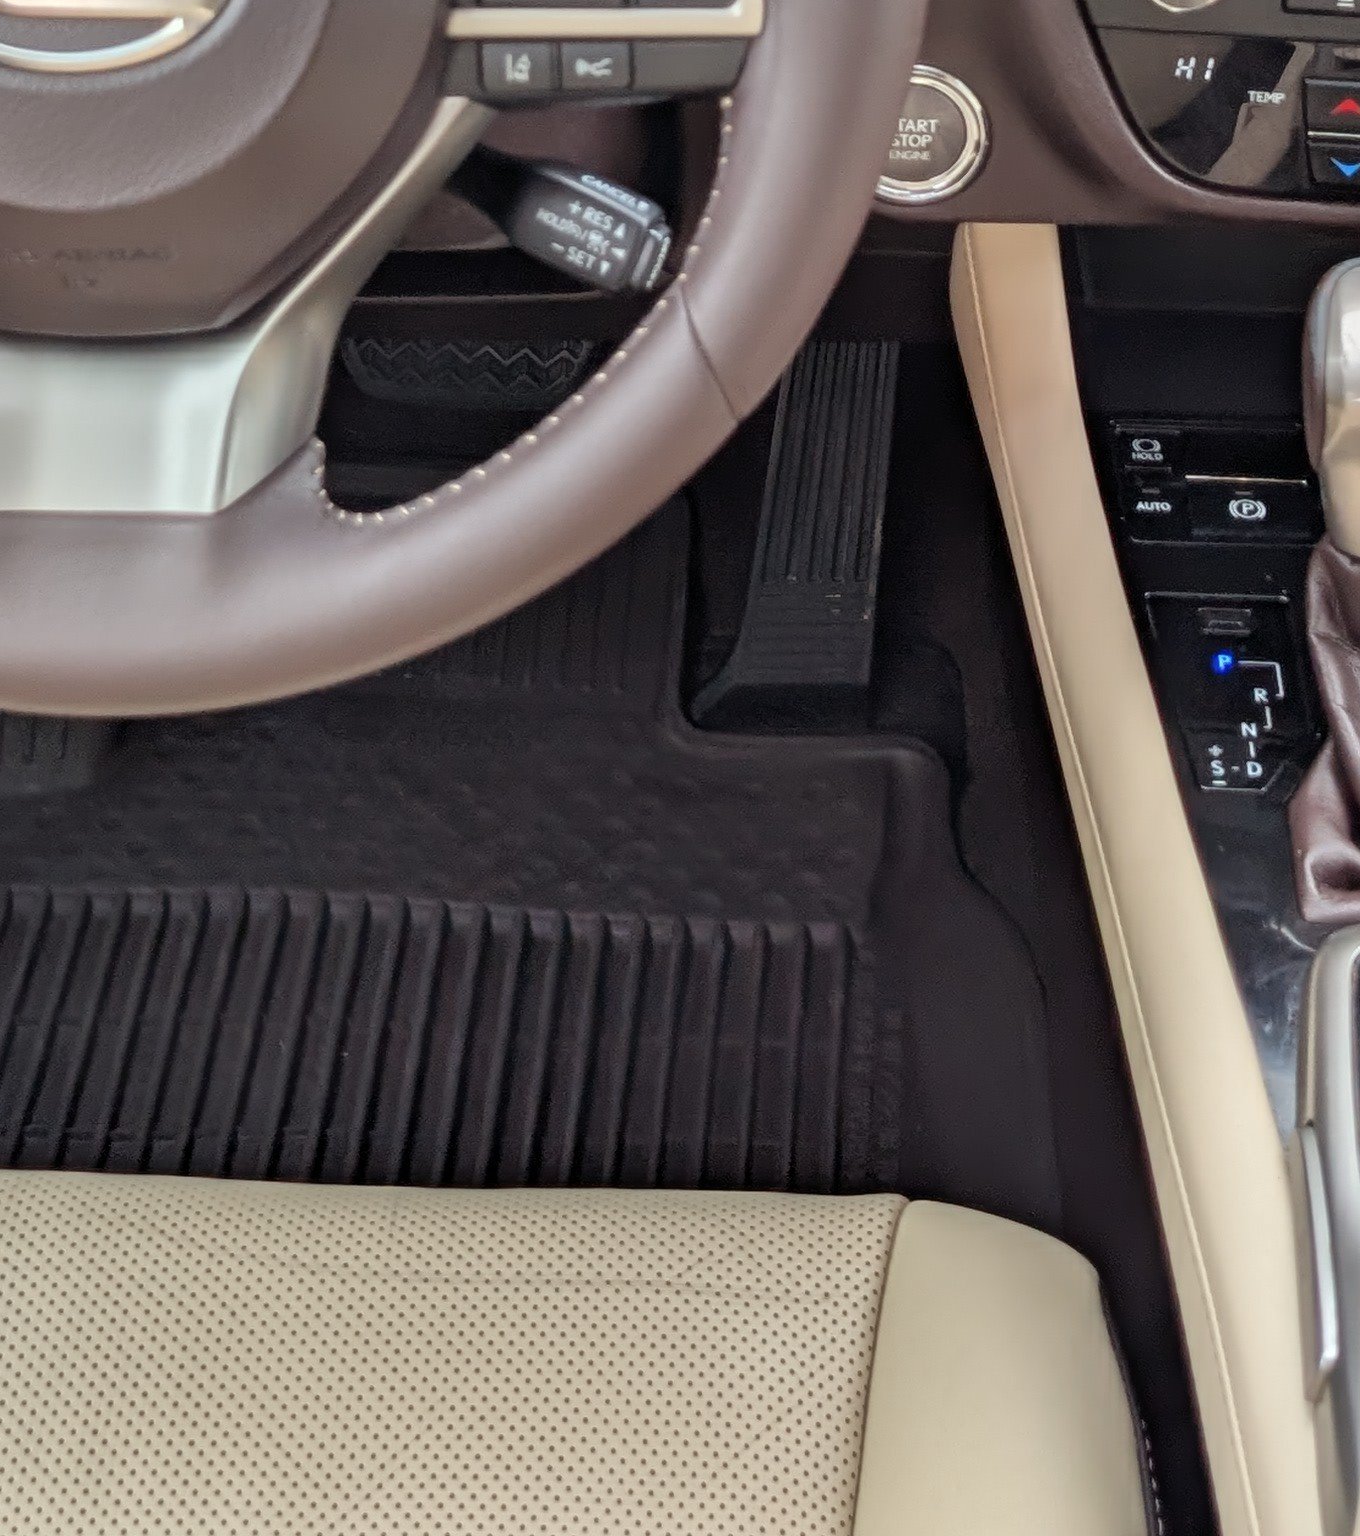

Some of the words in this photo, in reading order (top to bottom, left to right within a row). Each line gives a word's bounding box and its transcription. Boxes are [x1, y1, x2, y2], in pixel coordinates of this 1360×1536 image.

[1246, 90, 1287, 105] TEMP
[1135, 500, 1172, 513] AUTO
[1217, 654, 1233, 669] P
[1253, 688, 1269, 703] R
[1240, 722, 1258, 737] N
[1210, 760, 1225, 776] S
[1246, 761, 1263, 777] D
